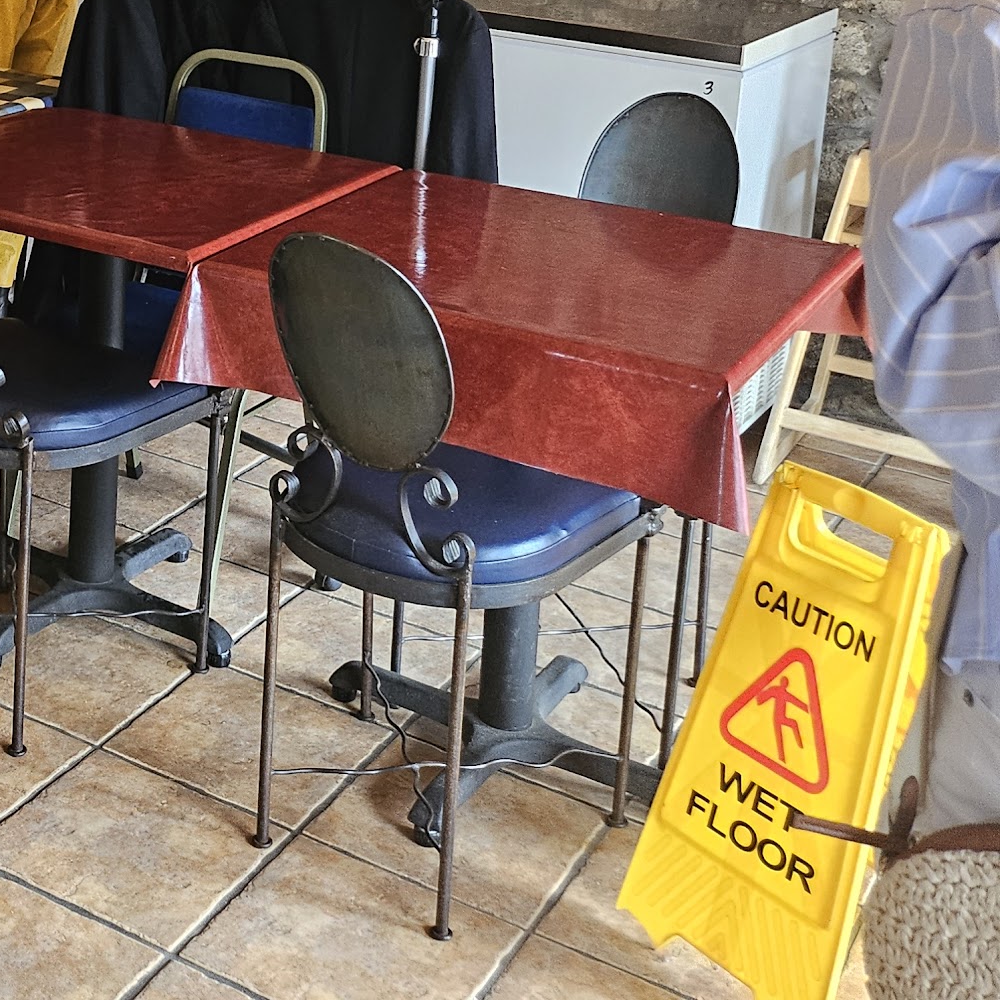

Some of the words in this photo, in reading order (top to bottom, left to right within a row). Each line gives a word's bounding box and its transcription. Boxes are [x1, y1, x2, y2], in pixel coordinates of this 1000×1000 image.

[703, 81, 714, 95] 3
[754, 580, 877, 663] CAUTION
[719, 761, 806, 833] WET
[686, 788, 815, 895] FLOOR
